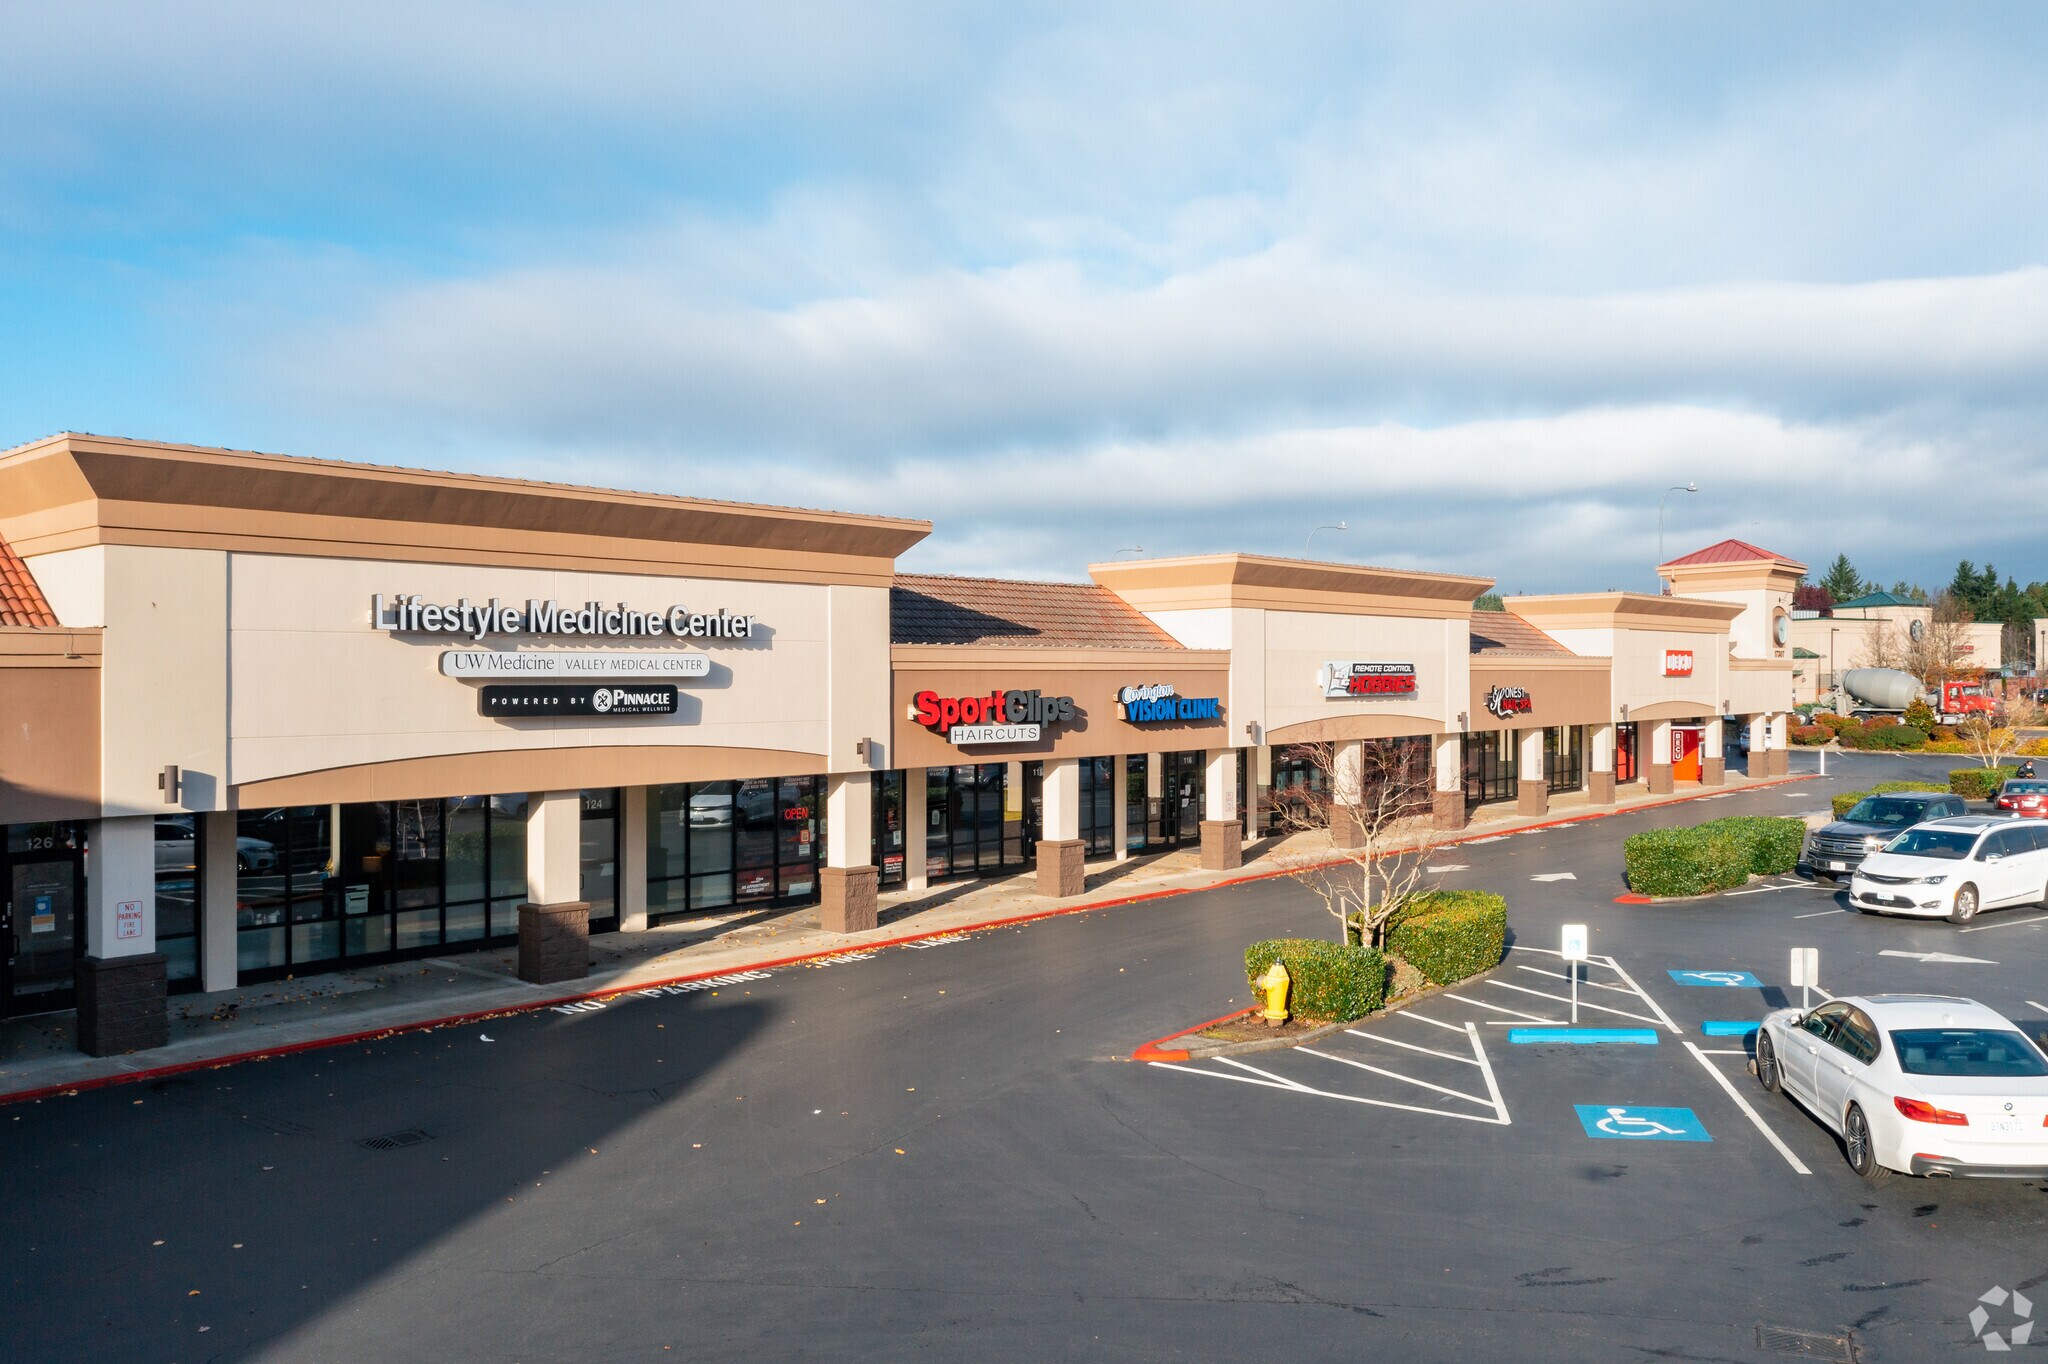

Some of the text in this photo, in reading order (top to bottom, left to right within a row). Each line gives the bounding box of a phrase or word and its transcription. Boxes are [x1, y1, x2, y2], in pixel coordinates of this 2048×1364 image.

[373, 594, 756, 641] Lifestyle Medicine Center
[454, 653, 555, 671] UW Medicine
[565, 659, 703, 671] VALLEY MEDICAL CENTER
[1354, 664, 1413, 673] REMOTE CONTROL
[1349, 674, 1416, 694] HOBBIES
[612, 689, 671, 706] PINNACLE
[1121, 683, 1175, 705] Covington
[491, 696, 586, 706] POWERED BY
[1128, 697, 1220, 722] VISION CLINIC
[953, 727, 1038, 742] HAIRCUTS
[1674, 732, 1682, 761] BECU
[1183, 756, 1193, 764] 116
[585, 799, 602, 810] 124
[785, 807, 809, 820] OPEN
[26, 837, 54, 850] 126
[124, 903, 135, 911] NO
[118, 912, 142, 921] PARKING
[123, 921, 136, 929] FIRE
[123, 929, 137, 937] LANE
[638, 970, 772, 999] PARKING
[551, 1000, 607, 1016] NO
